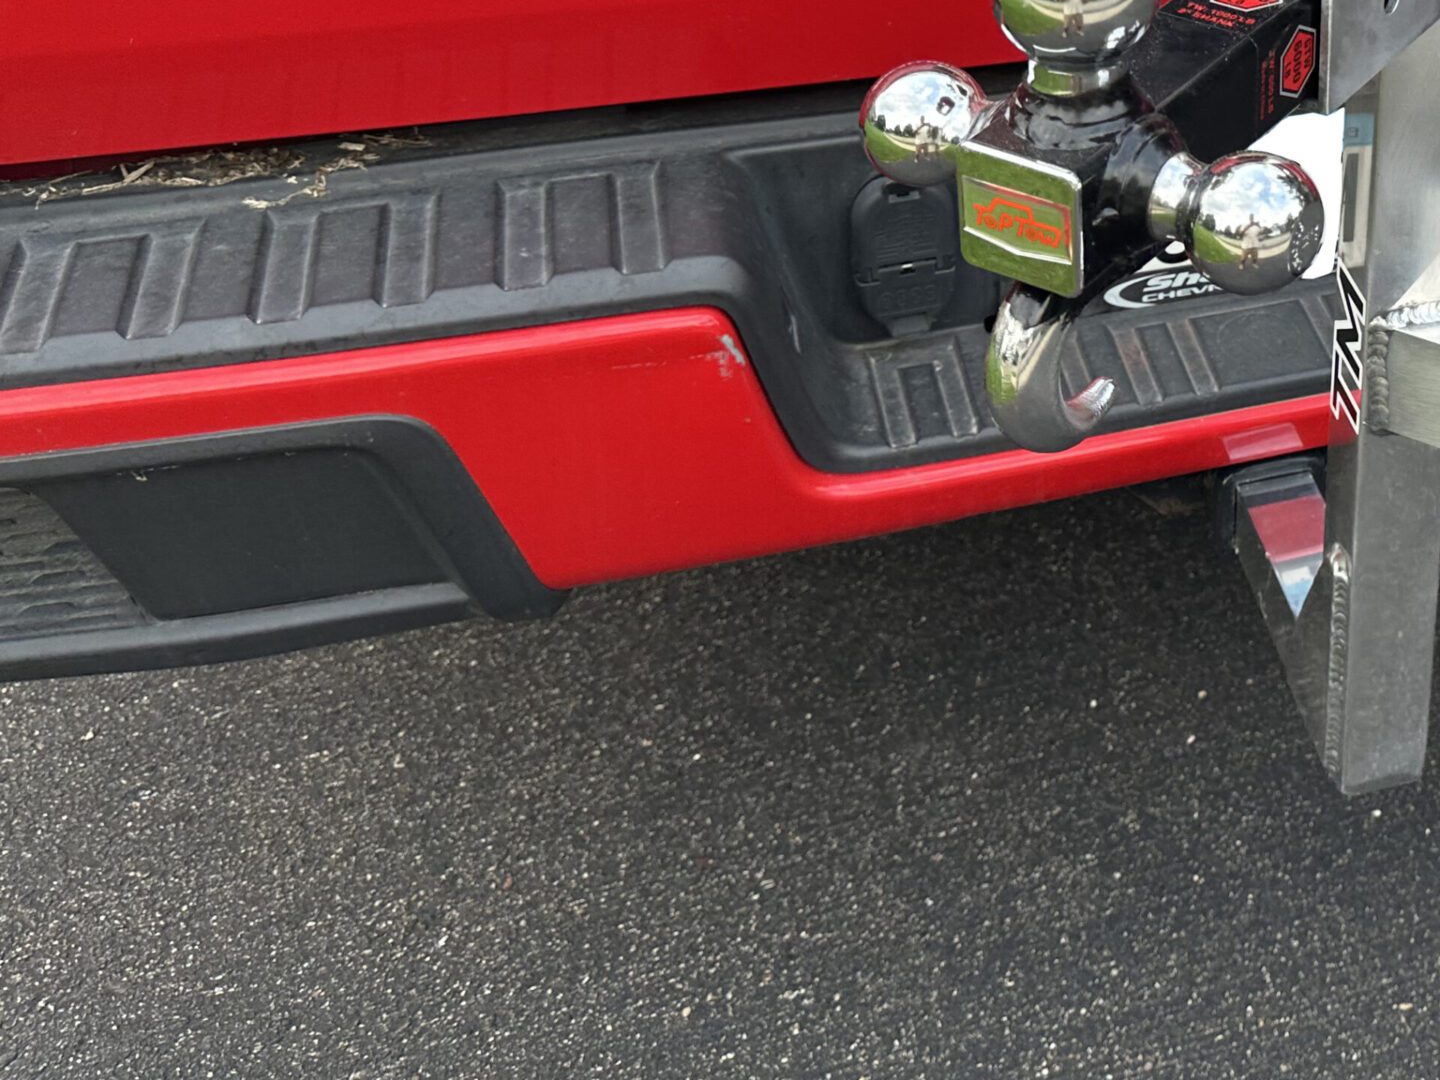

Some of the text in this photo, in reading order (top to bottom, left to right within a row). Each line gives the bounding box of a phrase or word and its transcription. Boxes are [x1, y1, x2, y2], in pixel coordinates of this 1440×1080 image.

[1292, 41, 1303, 84] 6000
[1303, 38, 1312, 69] GTW
[1143, 271, 1210, 293] Sh
